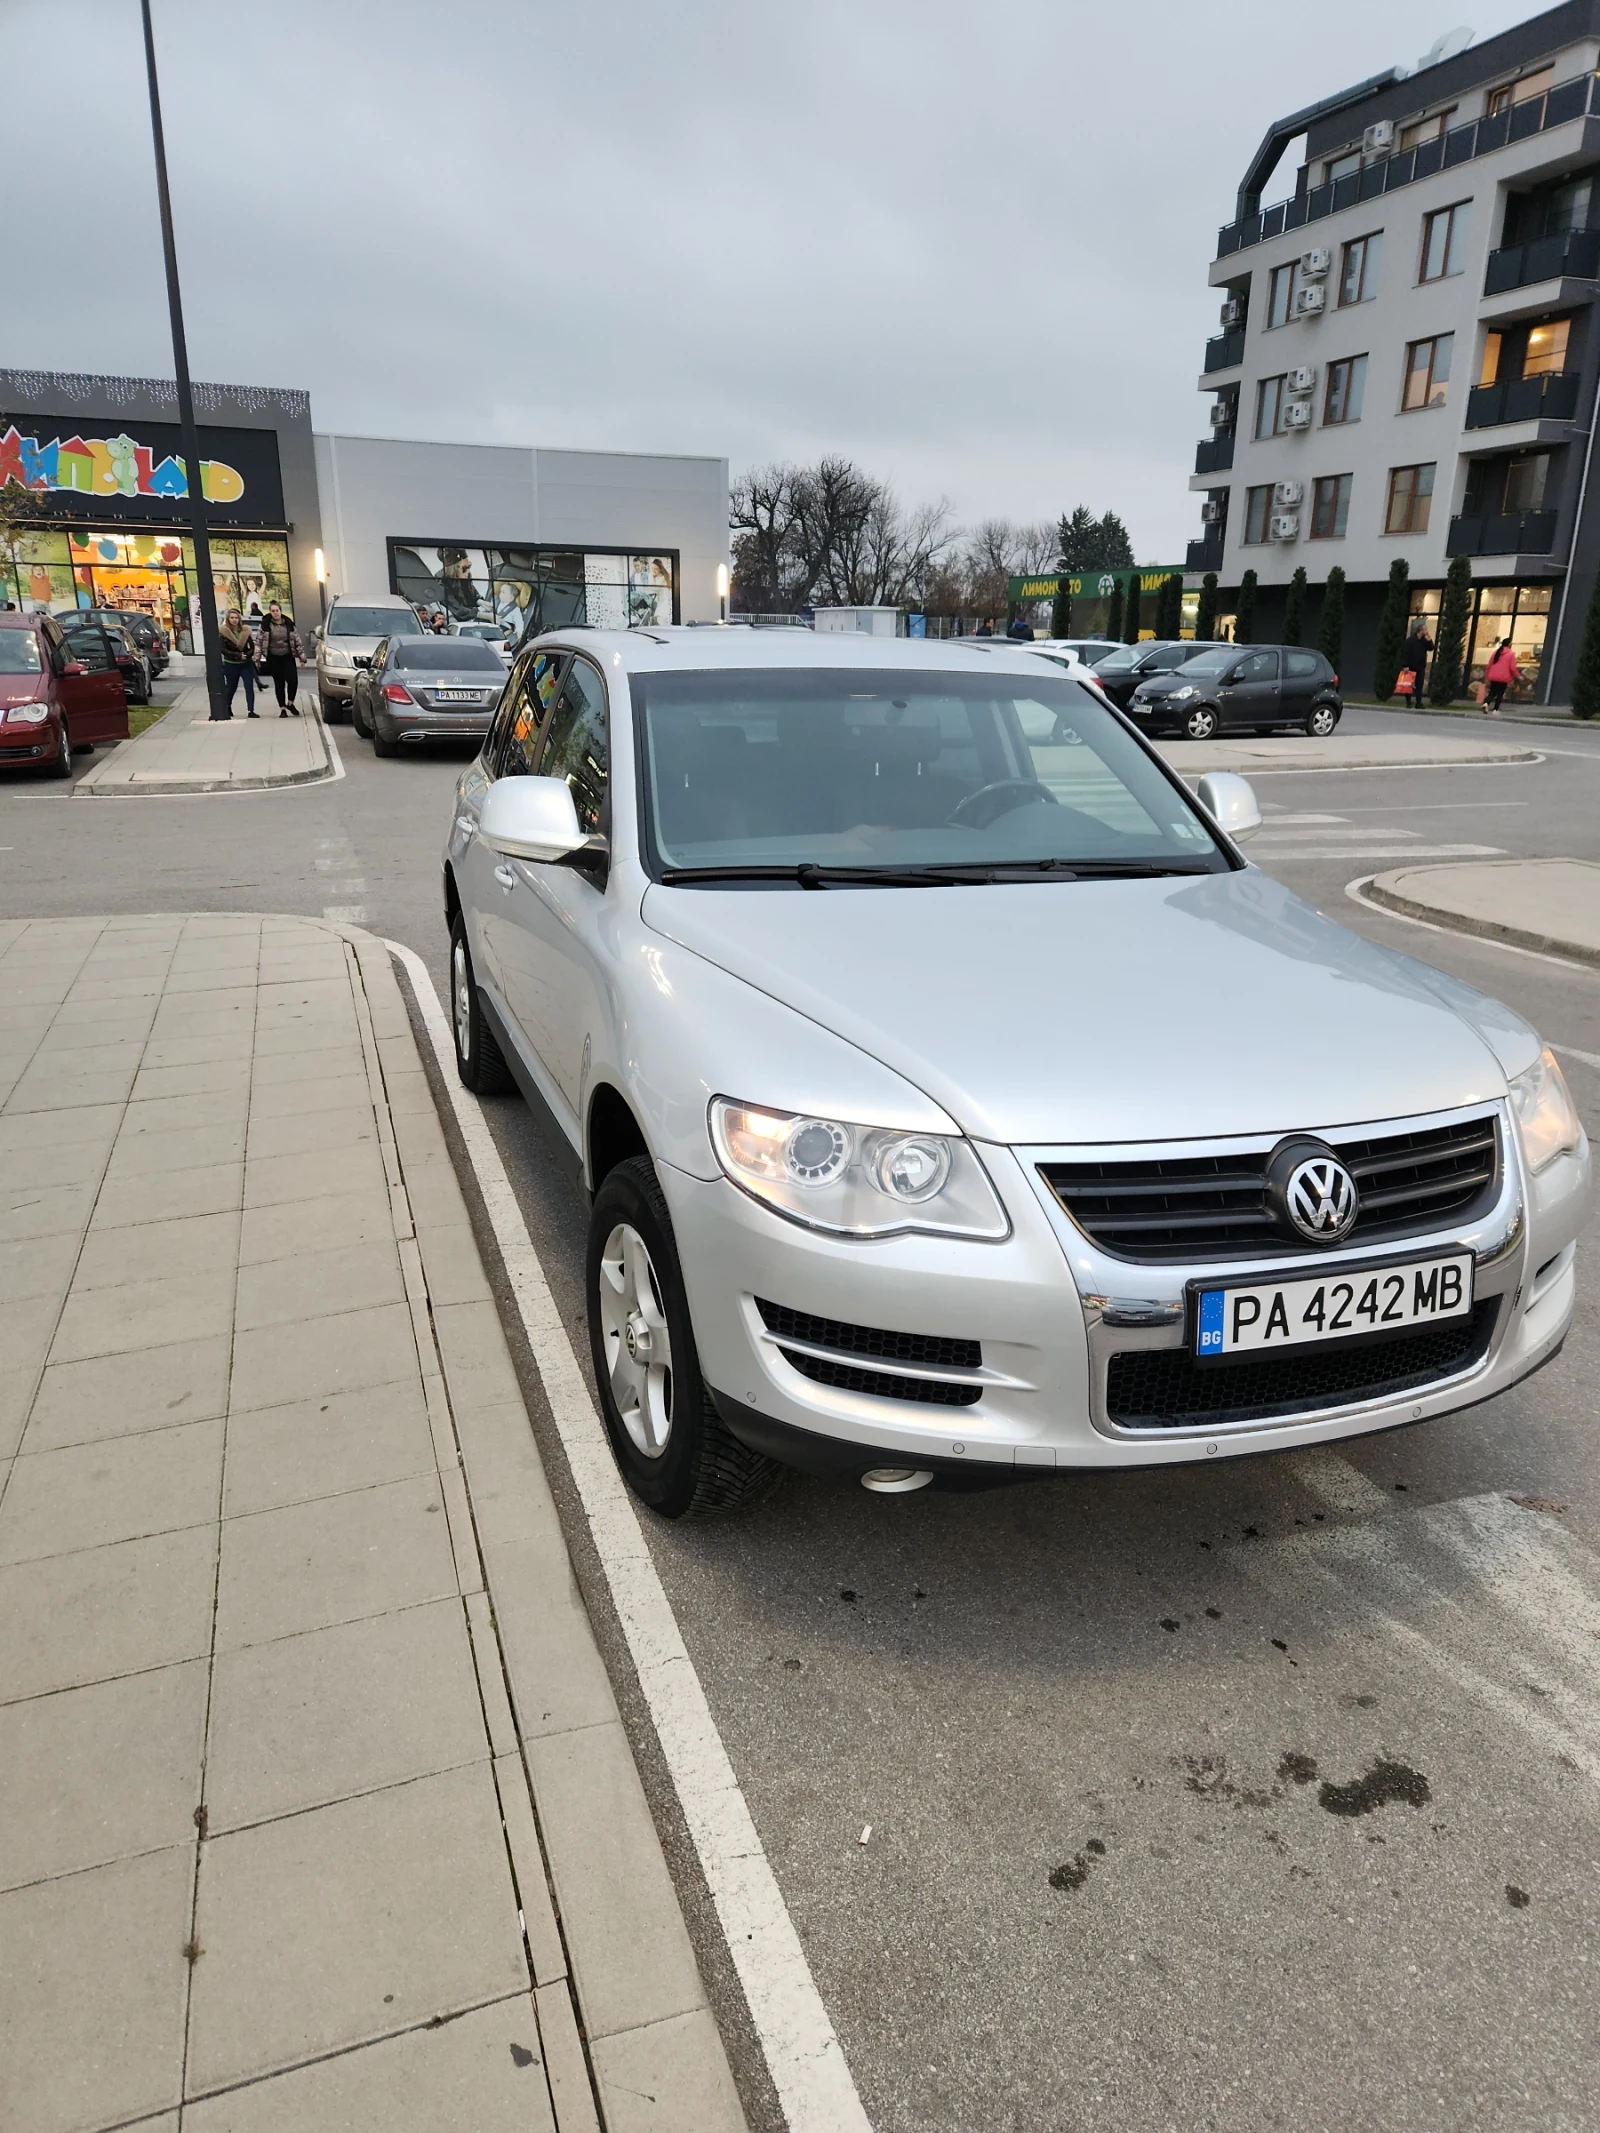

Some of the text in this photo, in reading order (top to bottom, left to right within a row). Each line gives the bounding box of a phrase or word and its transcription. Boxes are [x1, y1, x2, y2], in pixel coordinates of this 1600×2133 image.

[1021, 578, 1082, 597] ЛИМОНТО
[1232, 1264, 1463, 1344] PA 4242 MB
[1201, 1330, 1222, 1347] BG
